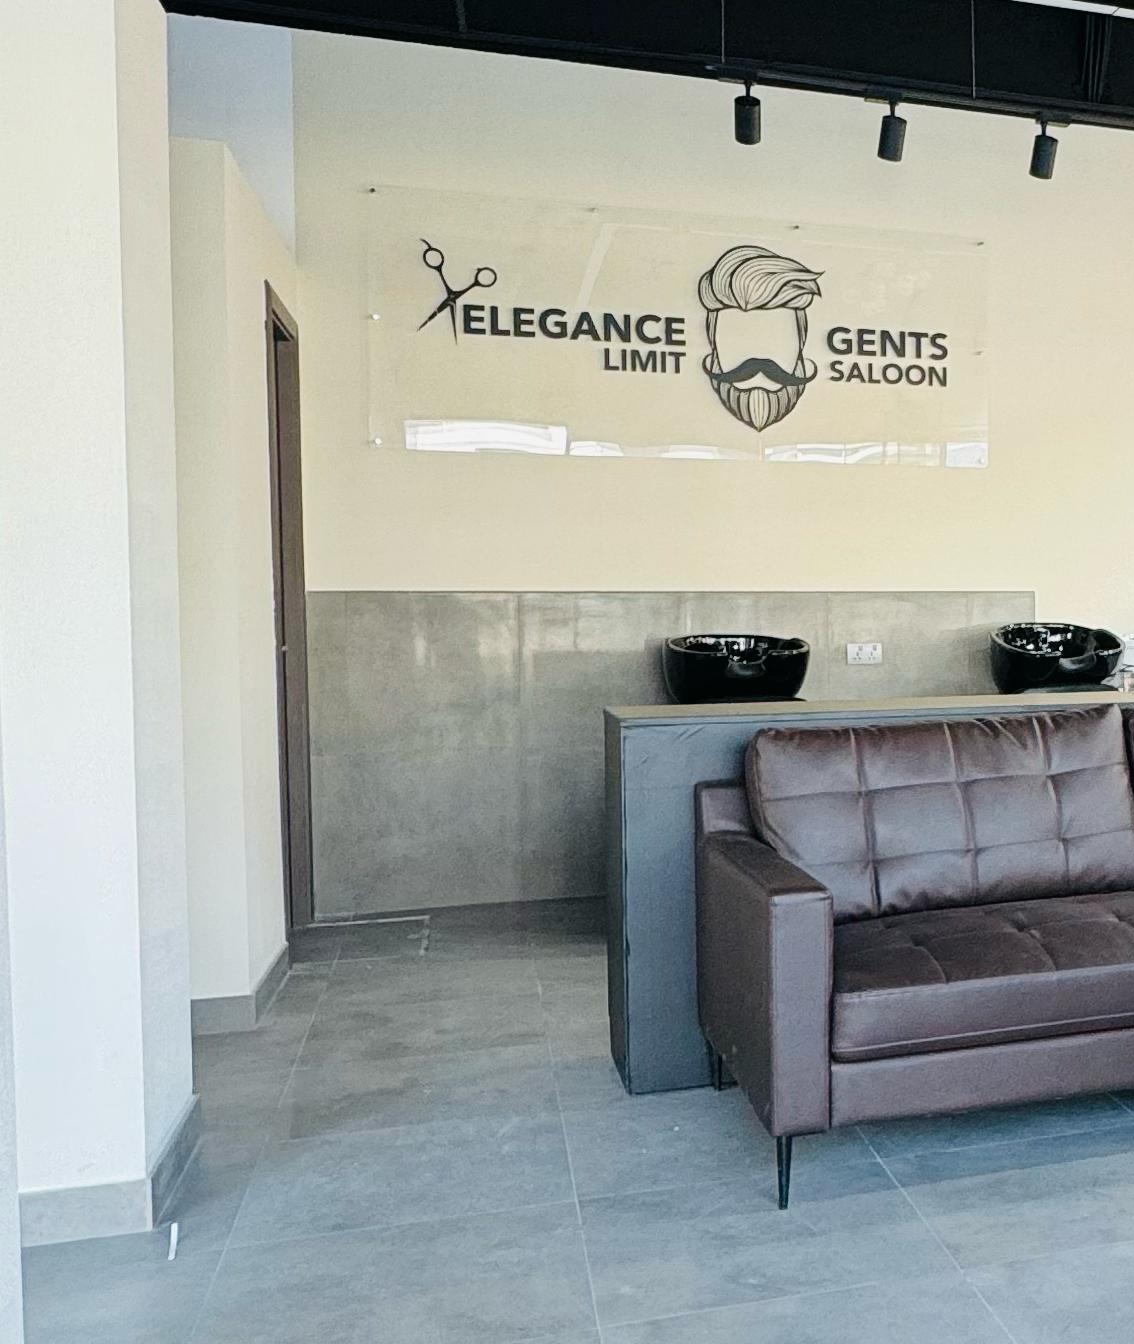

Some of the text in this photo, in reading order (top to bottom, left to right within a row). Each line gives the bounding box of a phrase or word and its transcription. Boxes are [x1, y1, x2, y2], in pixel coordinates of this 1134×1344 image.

[463, 304, 686, 346] ELEGANCE
[826, 326, 948, 361] GENTS
[603, 348, 686, 374] LIMIT
[828, 359, 948, 387] SALOON
